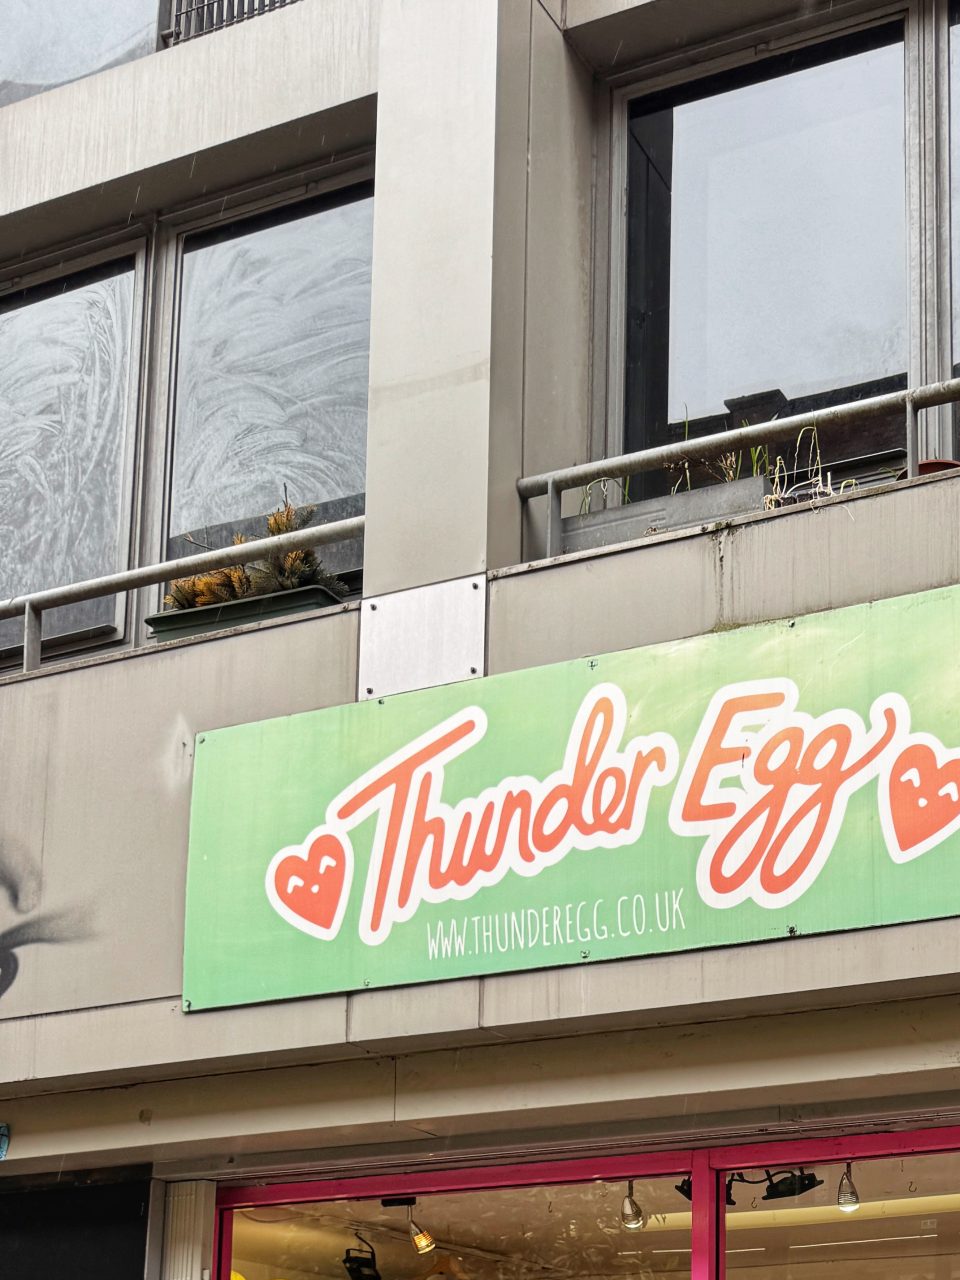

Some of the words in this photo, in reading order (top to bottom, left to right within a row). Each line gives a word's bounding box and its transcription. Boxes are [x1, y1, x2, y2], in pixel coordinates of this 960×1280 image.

[337, 694, 668, 933] Thunder
[682, 691, 898, 895] Egg
[427, 887, 686, 961] WWW.THUNDEREGG.CO.UK
